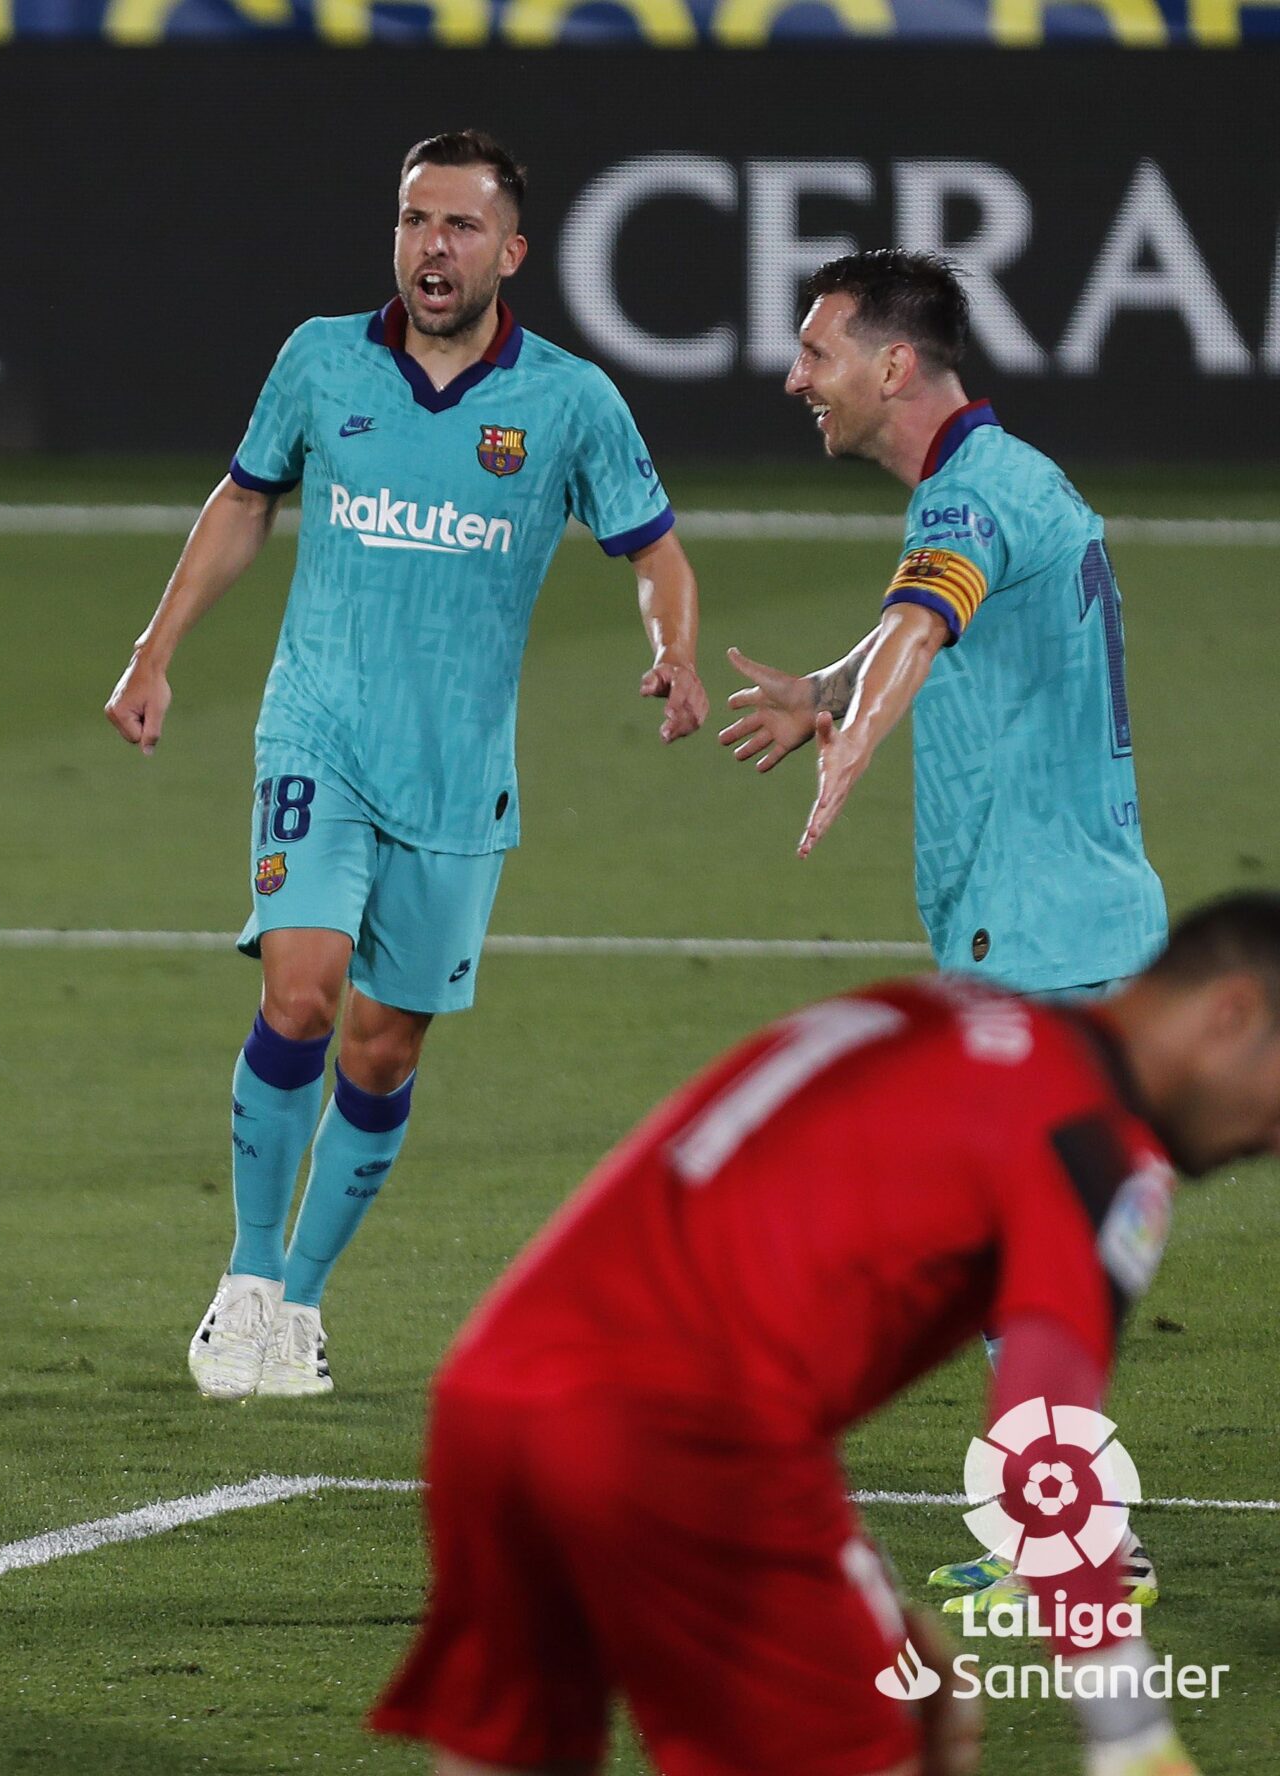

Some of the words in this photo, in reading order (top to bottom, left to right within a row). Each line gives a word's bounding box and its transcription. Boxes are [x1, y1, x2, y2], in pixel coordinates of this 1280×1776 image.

[557, 151, 1280, 377] CERA
[329, 483, 513, 553] Rakuten
[256, 773, 316, 850] 18
[666, 997, 910, 1190] 1
